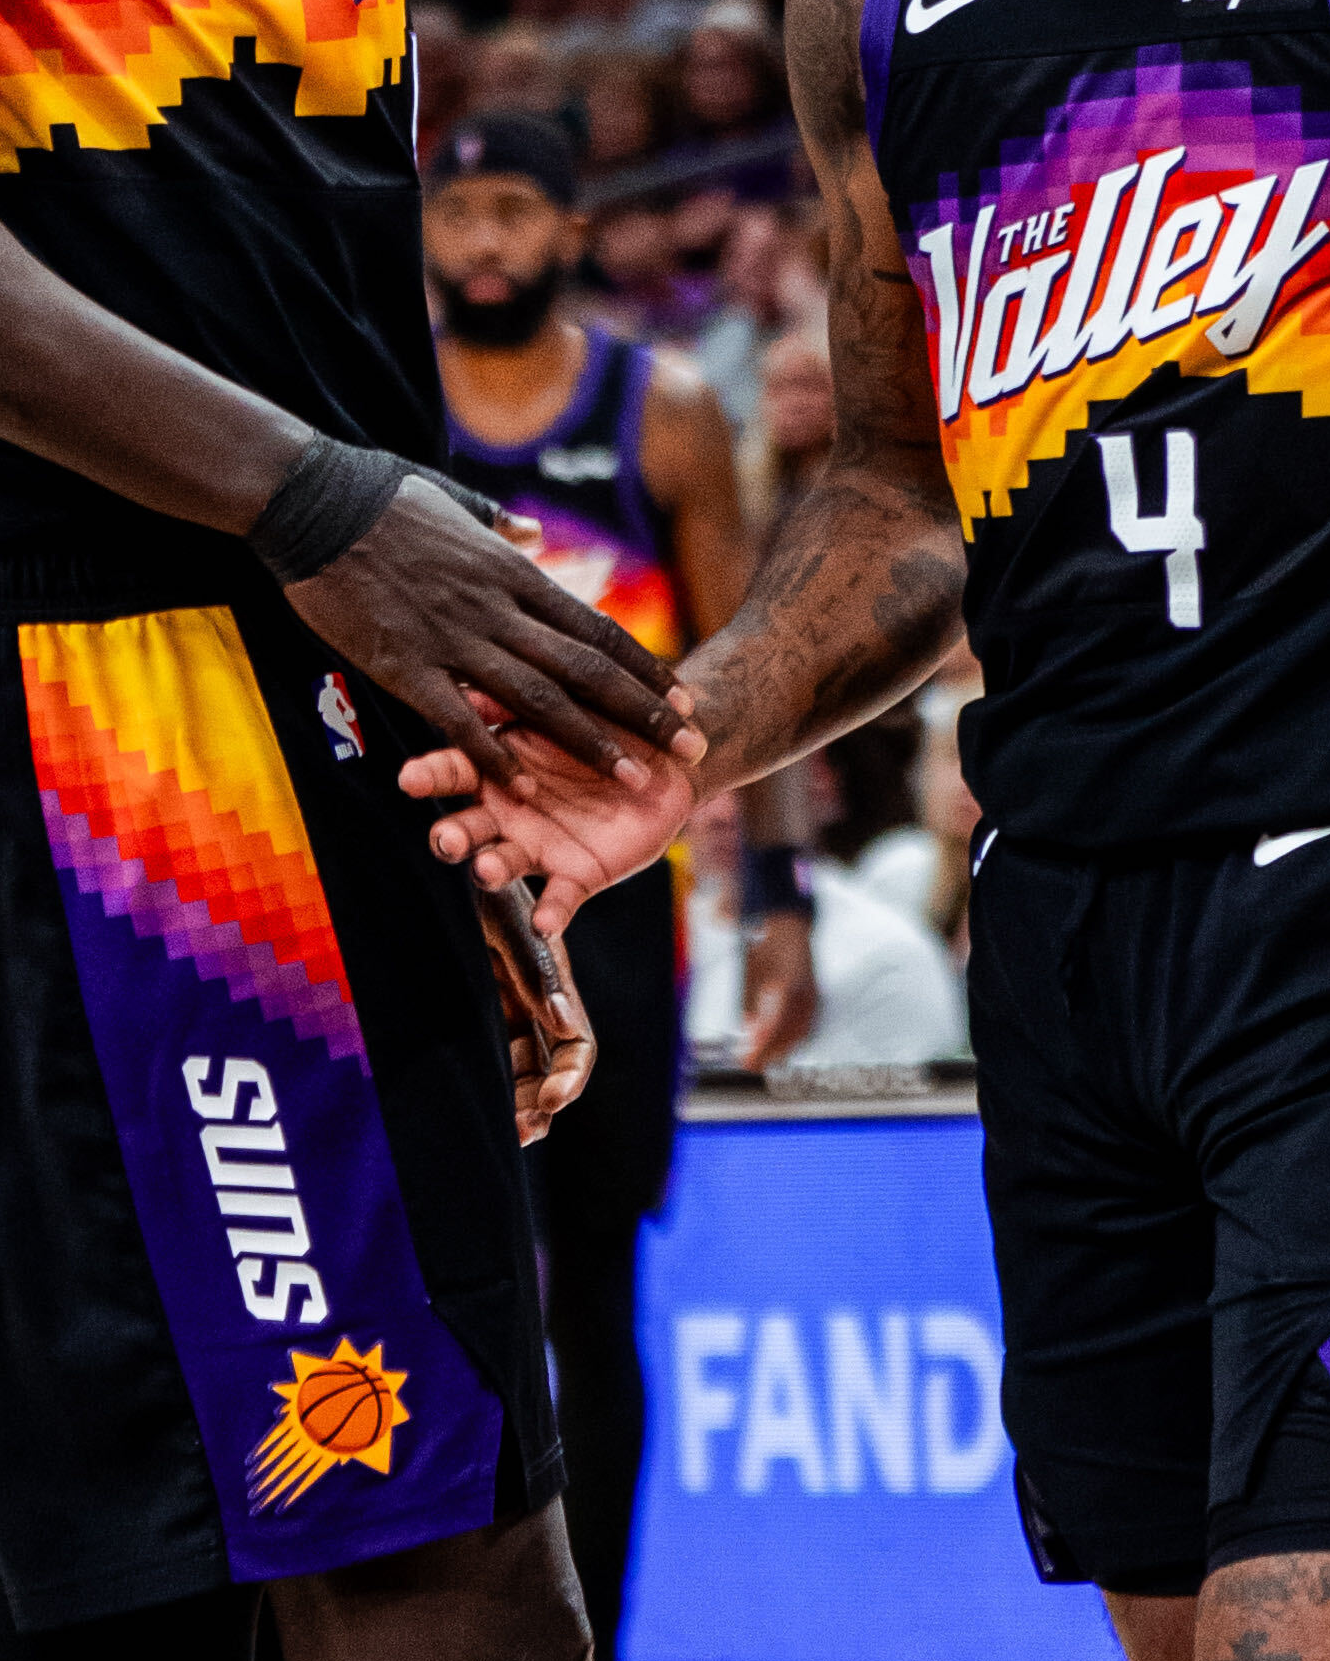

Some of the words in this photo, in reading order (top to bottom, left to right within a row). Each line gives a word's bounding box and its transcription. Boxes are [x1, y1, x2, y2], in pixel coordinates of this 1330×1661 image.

[997, 202, 1075, 264] THE
[1096, 429, 1206, 628] 4
[181, 1054, 329, 1324] SUNS
[676, 1308, 1011, 1495] FAND
